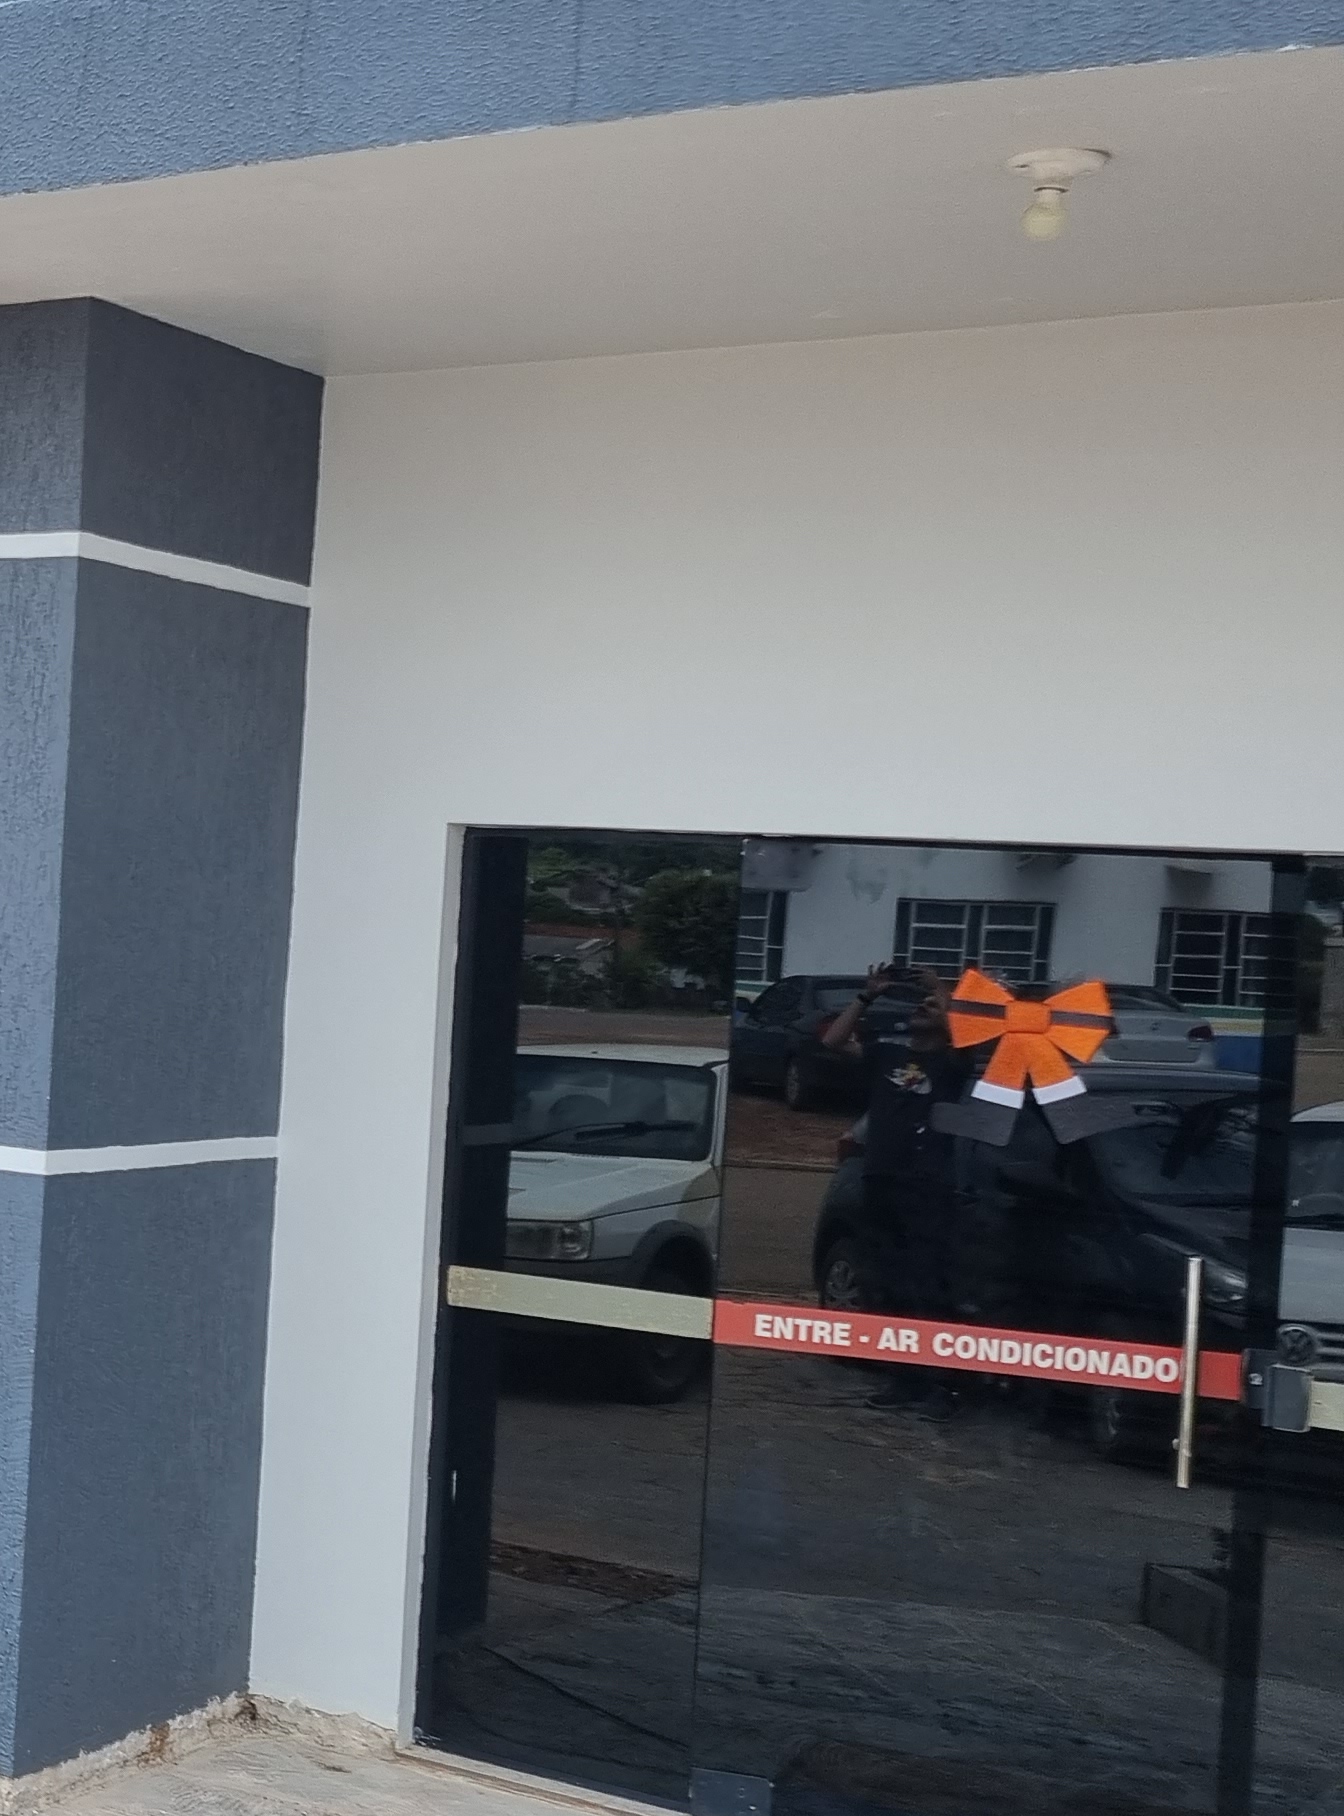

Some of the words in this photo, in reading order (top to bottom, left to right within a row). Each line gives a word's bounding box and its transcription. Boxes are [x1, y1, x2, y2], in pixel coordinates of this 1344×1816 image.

[754, 1313, 852, 1347] ENTRE
[877, 1326, 920, 1354] AR
[931, 1332, 1179, 1382] CONDICIONADO
